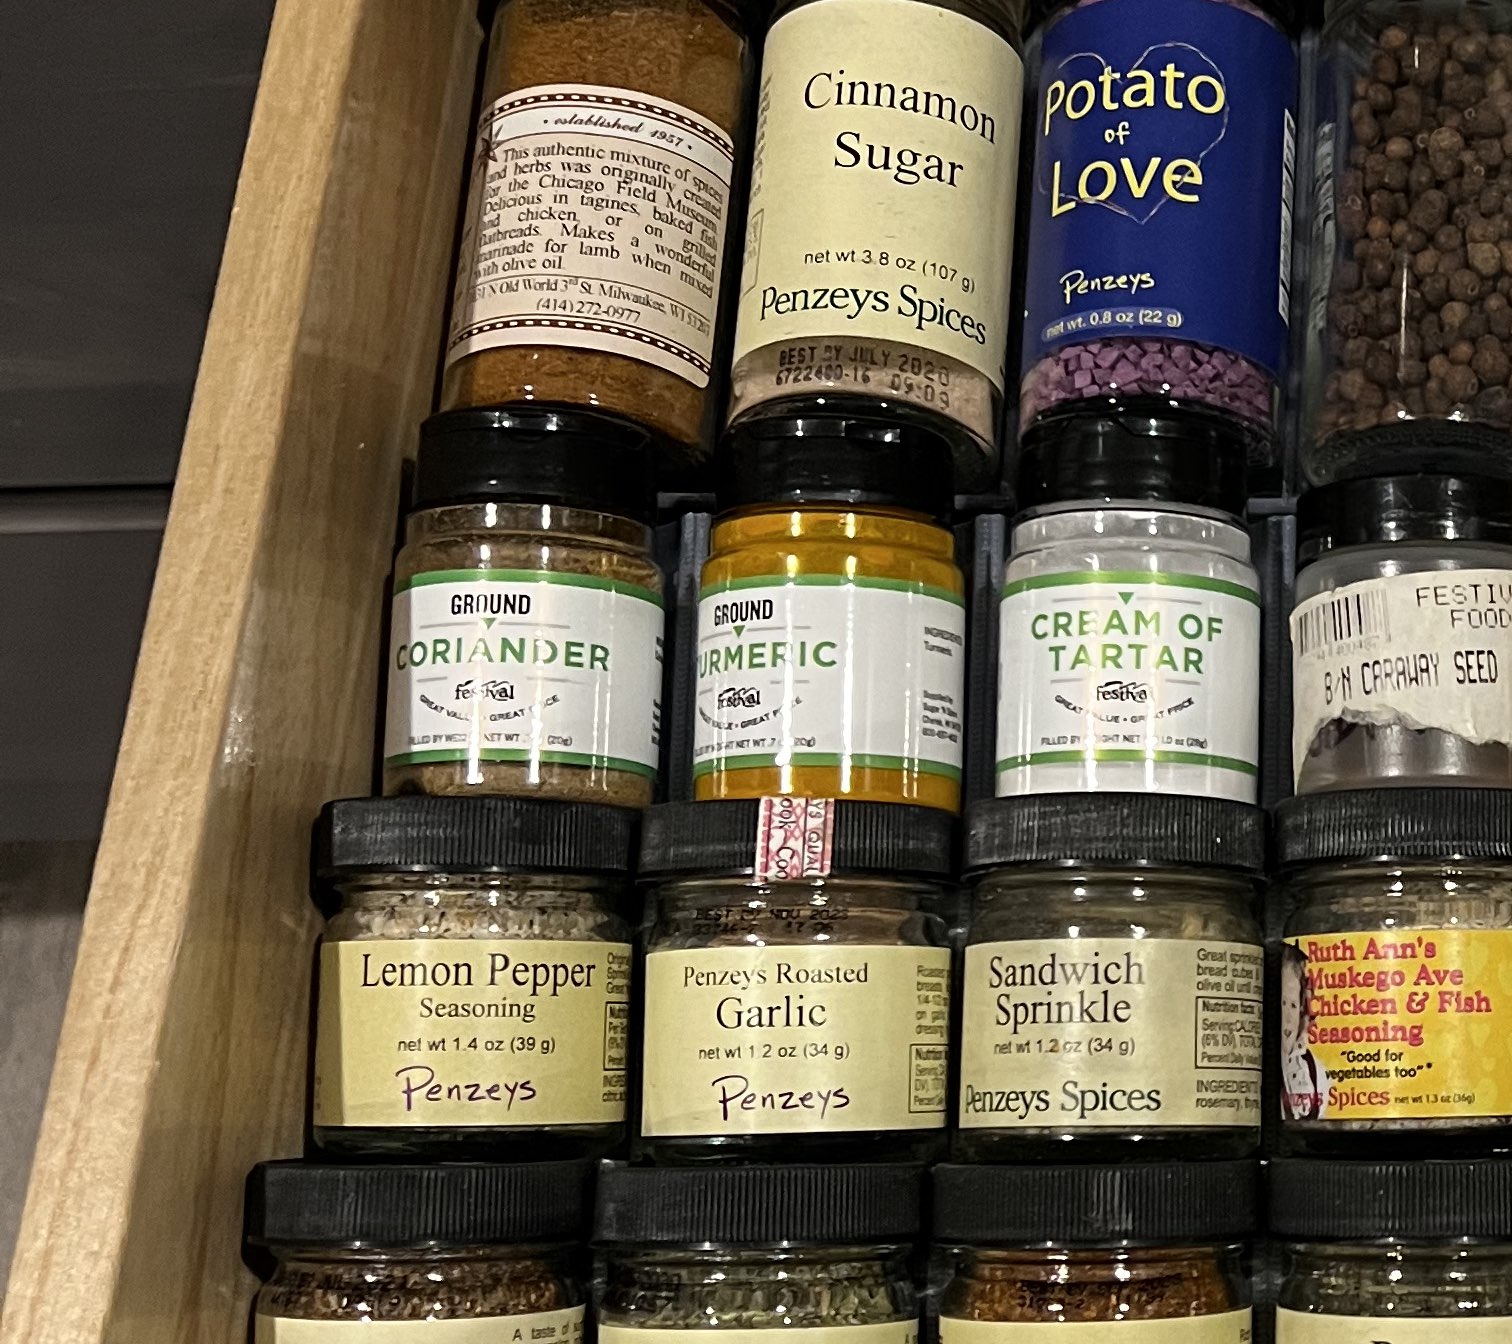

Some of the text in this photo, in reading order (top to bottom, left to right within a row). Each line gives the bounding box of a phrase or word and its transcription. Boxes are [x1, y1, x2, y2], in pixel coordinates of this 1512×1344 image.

[804, 69, 997, 145] Cinnamon
[554, 113, 684, 147] established 1957
[1104, 121, 1131, 145] of
[834, 130, 964, 188] Sugar
[1051, 157, 1203, 218] Love
[1059, 269, 1155, 304] Penzeys
[761, 284, 988, 345] Penzeys Spices
[450, 594, 531, 615] GROUND
[714, 599, 774, 627] GROUND
[1031, 609, 1223, 642] CREAM OF
[396, 636, 610, 672] CORIANDER
[699, 640, 838, 679] URMERIC
[1048, 643, 1203, 675] TARTAR
[1361, 654, 1440, 696] CARAWAY
[1454, 649, 1499, 685] SEED
[1307, 937, 1437, 963] Ruth Ann's
[361, 953, 596, 997] Lemon Pepper
[776, 963, 868, 985] Roasted
[989, 952, 1145, 988] Sandwich
[1306, 963, 1464, 992] Muskego Ave
[419, 997, 536, 1022] Seasoning
[716, 994, 827, 1029] Garlic
[995, 990, 1132, 1034] Sprinkle
[1306, 991, 1492, 1018] Chicken & Fish
[1307, 1020, 1424, 1046] Seasoning
[1385, 1050, 1403, 1062] for
[395, 1065, 536, 1111] Penzeys
[1325, 1066, 1390, 1082] vegetables
[711, 1075, 850, 1122] Penzeys
[965, 1080, 1161, 1119] Penzeys Spices
